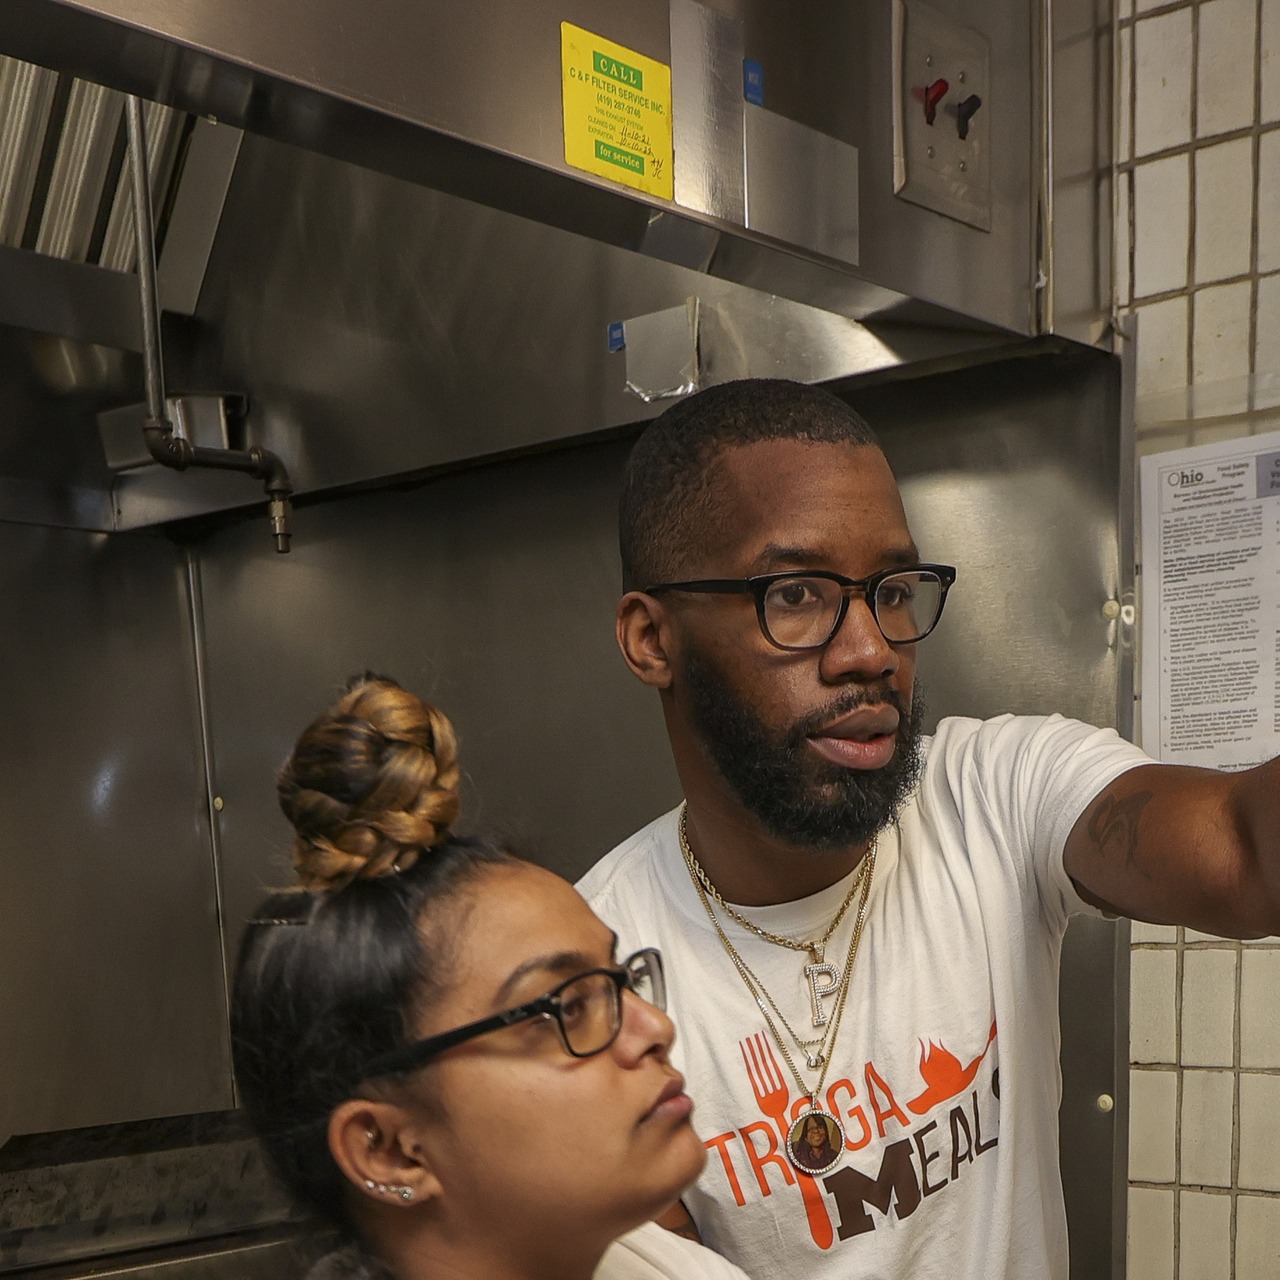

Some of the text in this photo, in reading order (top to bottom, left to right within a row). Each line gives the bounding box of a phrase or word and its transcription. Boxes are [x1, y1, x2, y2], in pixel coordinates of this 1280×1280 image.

[600, 58, 637, 84] CALL
[570, 67, 666, 116] C & F FILTER SERVICE INC.
[600, 144, 640, 169] for service
[1168, 469, 1204, 486] Ohio
